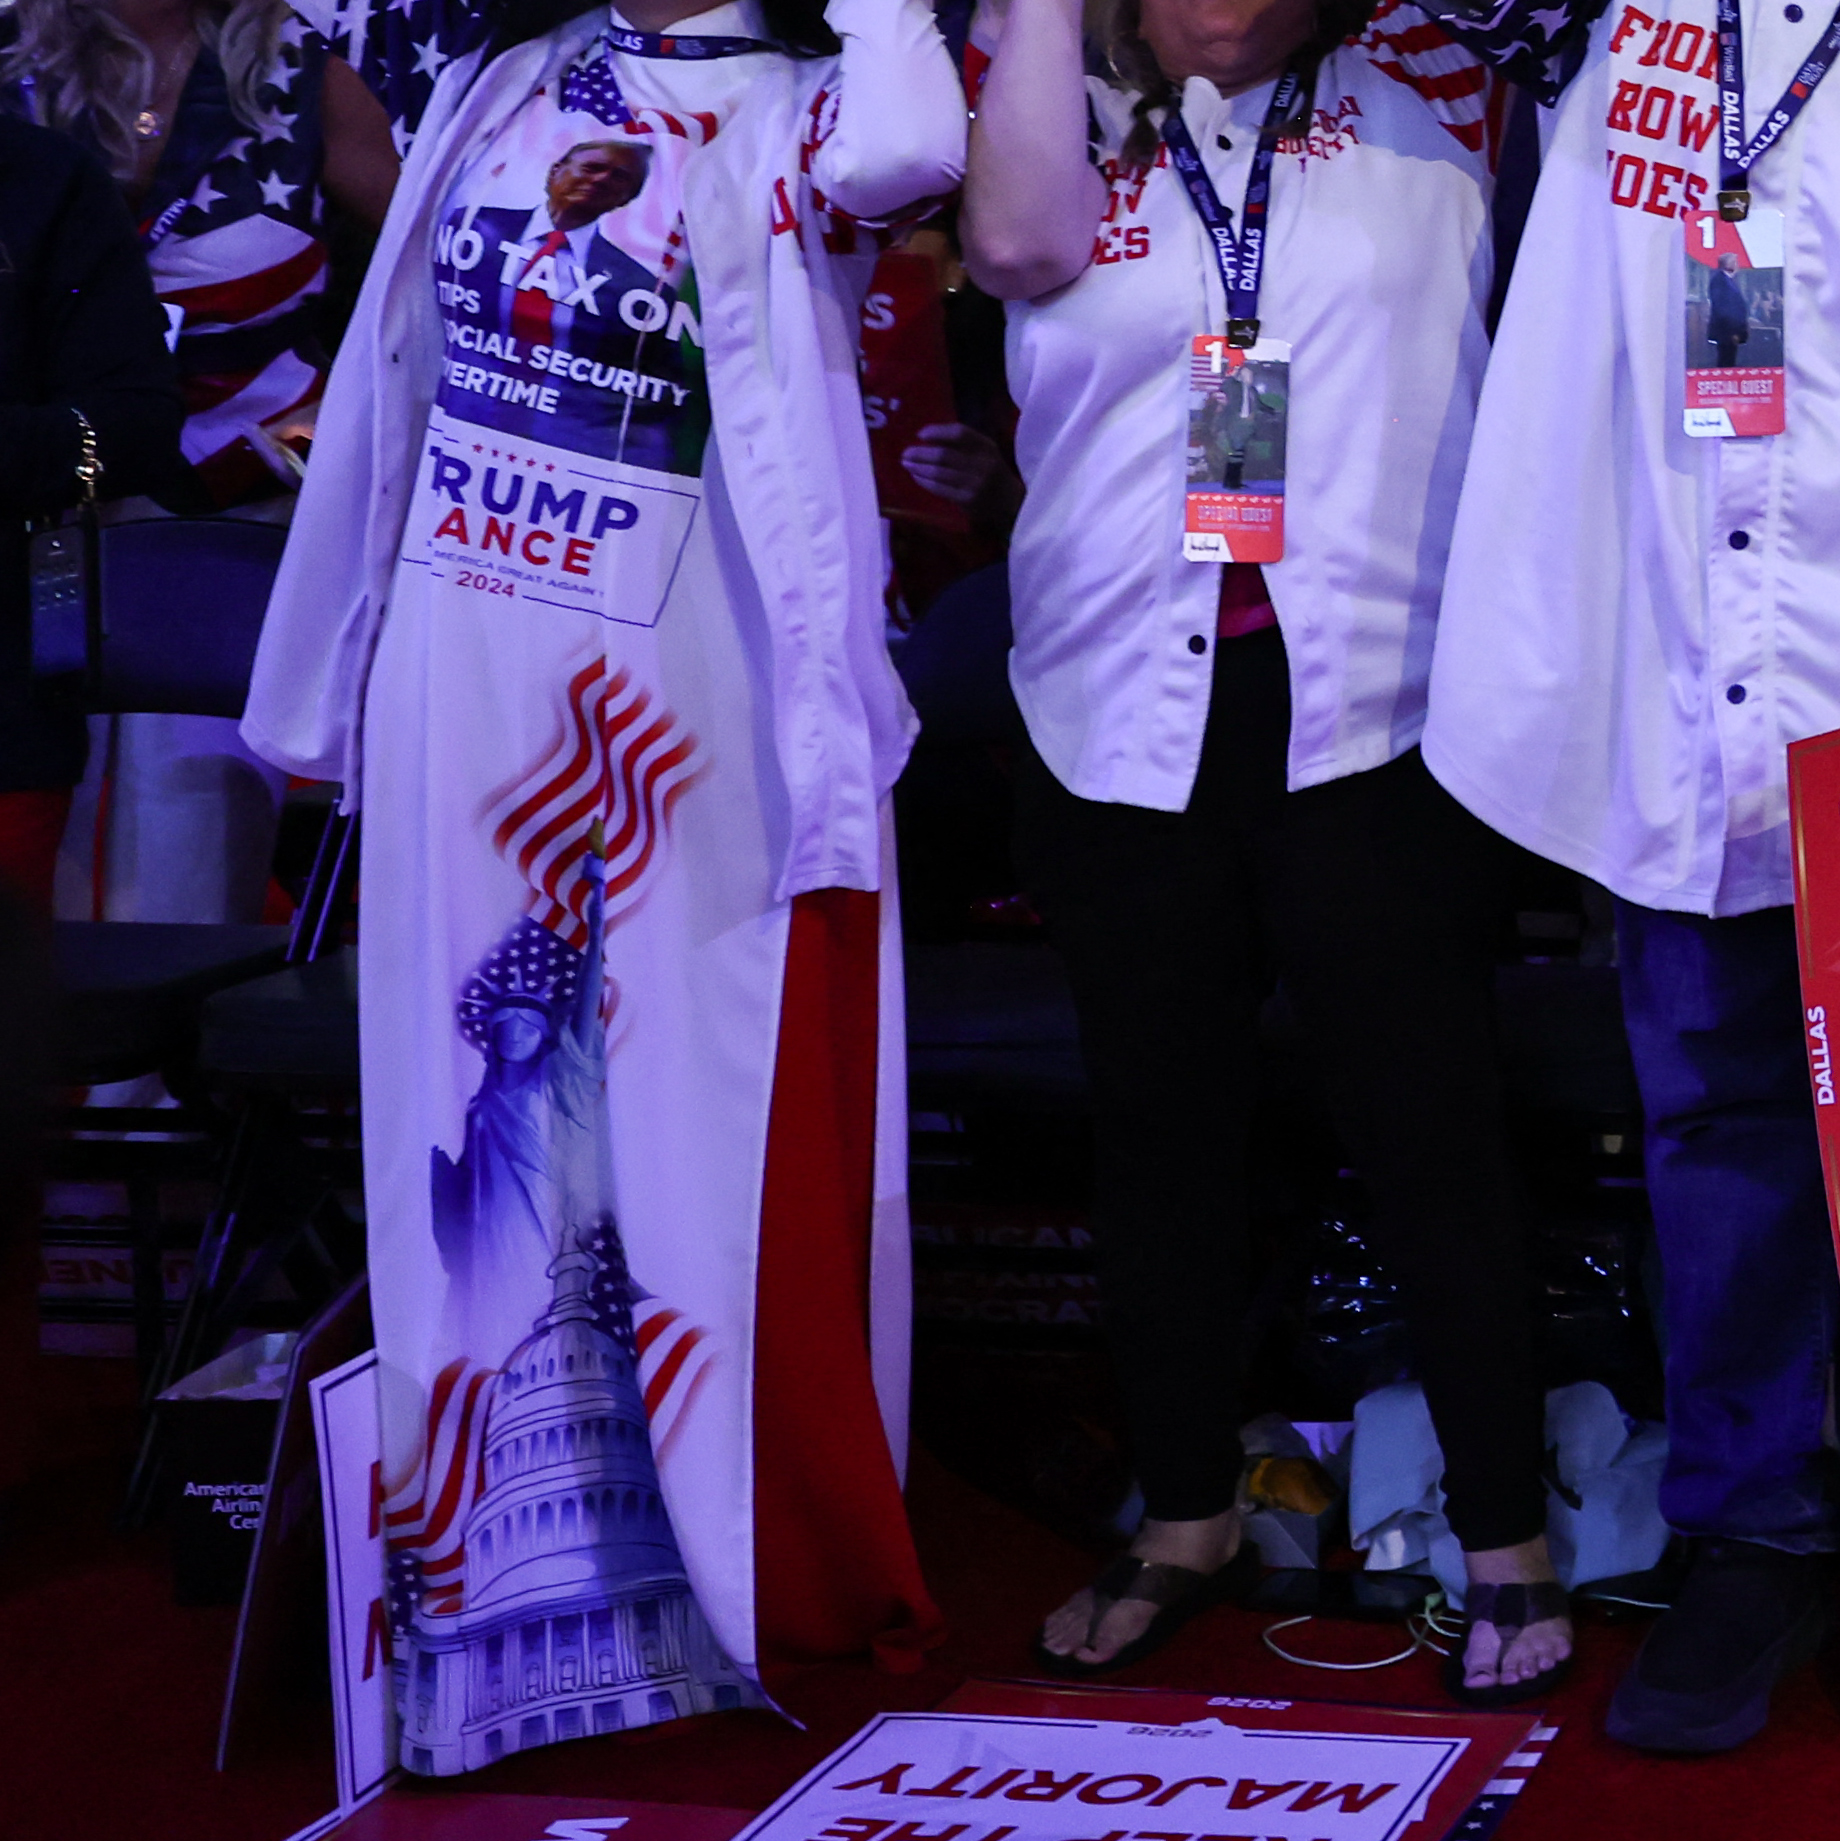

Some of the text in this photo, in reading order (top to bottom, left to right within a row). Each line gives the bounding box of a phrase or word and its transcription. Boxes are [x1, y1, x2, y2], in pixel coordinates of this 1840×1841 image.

[1606, 79, 1720, 154] ROW
[1722, 91, 1740, 160] DALLAS
[1738, 110, 1790, 169] DALLAS
[1212, 227, 1235, 290] DALLA
[1239, 228, 1262, 292] DALLAS
[1695, 219, 1715, 249] 1
[434, 224, 704, 348] NO TAX ON
[438, 282, 481, 314] TIPS
[445, 359, 560, 414] ERTIME
[528, 345, 690, 407] SECURITY
[1697, 379, 1773, 396] SPECIAL GUEST
[434, 507, 596, 576] ANCE
[455, 570, 516, 597] 2024
[1816, 1006, 1835, 1106] DALLAS
[184, 1482, 266, 1498] America
[834, 1763, 1401, 1814] MAJORITY
